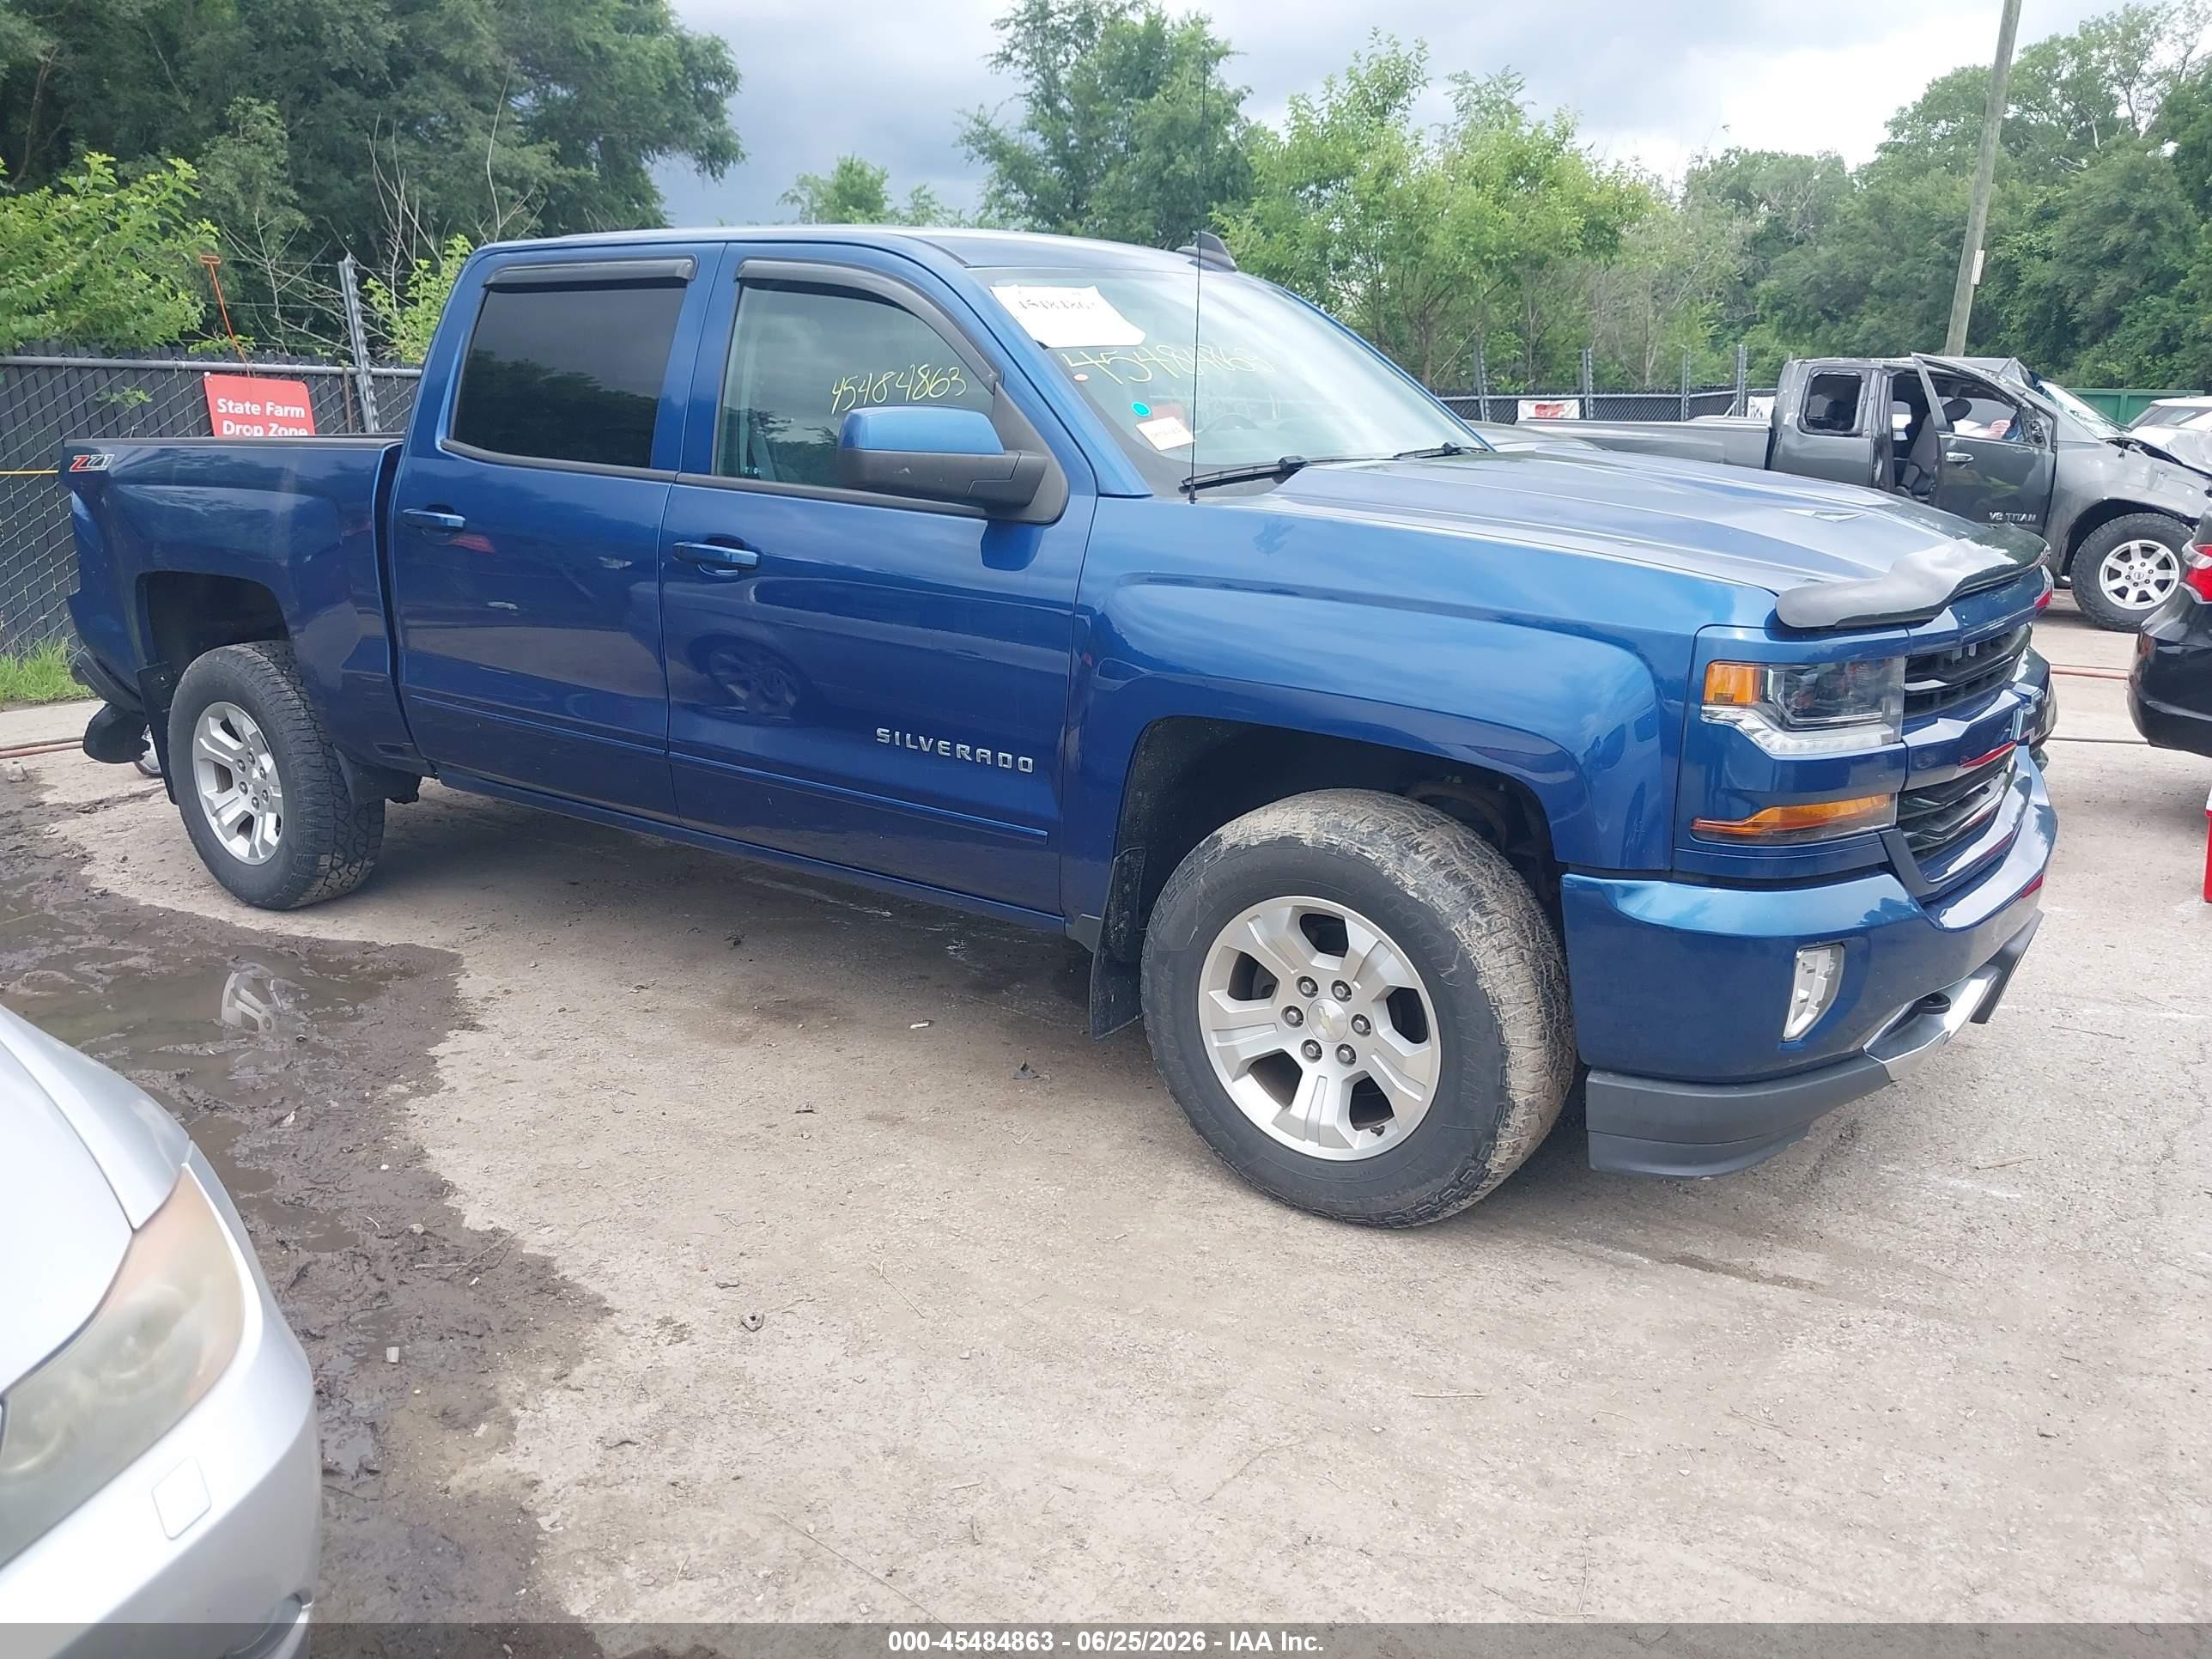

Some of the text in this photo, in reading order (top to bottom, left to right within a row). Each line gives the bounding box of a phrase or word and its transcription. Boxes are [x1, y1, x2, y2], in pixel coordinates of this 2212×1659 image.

[831, 363, 968, 415] 45484863
[217, 398, 306, 418] State Farm
[222, 420, 309, 436] Drop Zone
[69, 454, 115, 472] Z71
[1989, 512, 2037, 522] V8 TITAN
[876, 727, 1034, 773] SILVERADO
